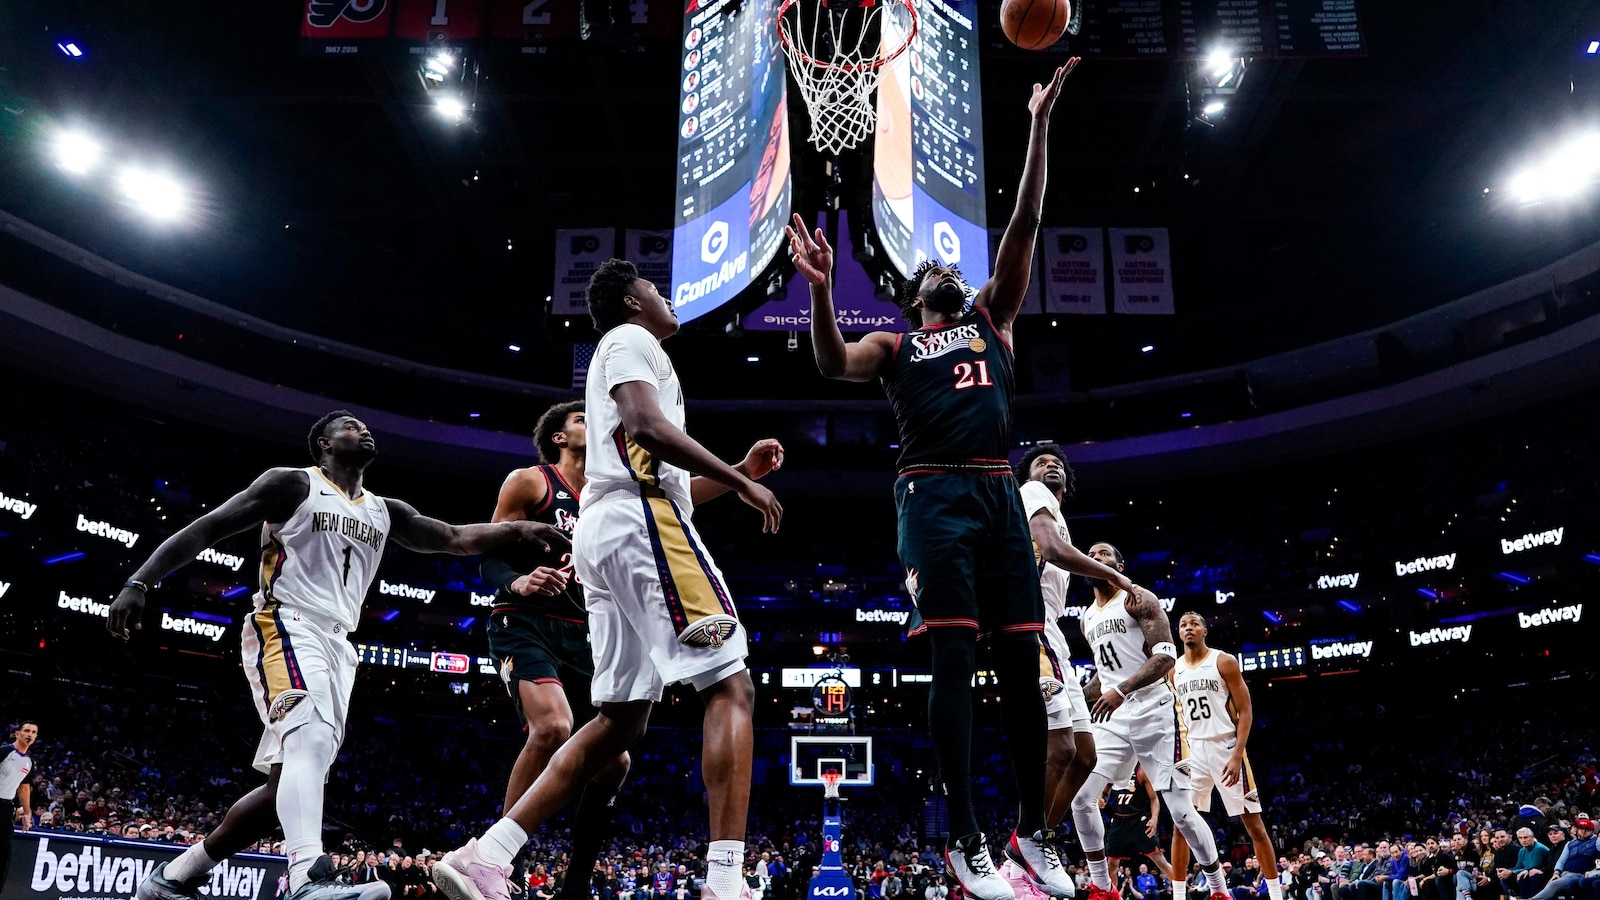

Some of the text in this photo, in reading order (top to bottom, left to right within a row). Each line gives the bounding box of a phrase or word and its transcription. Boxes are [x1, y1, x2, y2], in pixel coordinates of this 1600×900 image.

[675, 251, 748, 307] ComAve
[1120, 276, 1164, 284] CHAMPIONS
[764, 315, 895, 327] xfinity obile
[953, 360, 994, 390] 21
[76, 514, 140, 549] betway
[312, 512, 384, 553] NEW ORLEANS
[1501, 530, 1564, 558] betway
[196, 547, 245, 571] tway
[342, 545, 353, 587] 1
[1395, 553, 1457, 578] betway
[379, 580, 437, 604] betway
[1318, 576, 1360, 593] tway
[58, 591, 110, 618] betwa
[470, 592, 497, 608] bet
[161, 612, 226, 641] betway
[856, 608, 910, 625] betway
[1518, 604, 1583, 632] betway
[1096, 618, 1127, 640] ORLEANS
[1409, 624, 1472, 646] betway
[1100, 641, 1123, 672] 41
[1162, 645, 1172, 653] 41
[1311, 641, 1373, 660] betway
[762, 673, 770, 684] 2
[873, 673, 881, 685] 2
[1189, 679, 1219, 693] ORLEANS
[828, 695, 843, 712] 14
[1187, 696, 1211, 721] 25
[1118, 793, 1134, 806] 77
[824, 840, 840, 853] 76
[199, 859, 267, 900] tway
[813, 887, 849, 897] KIA
